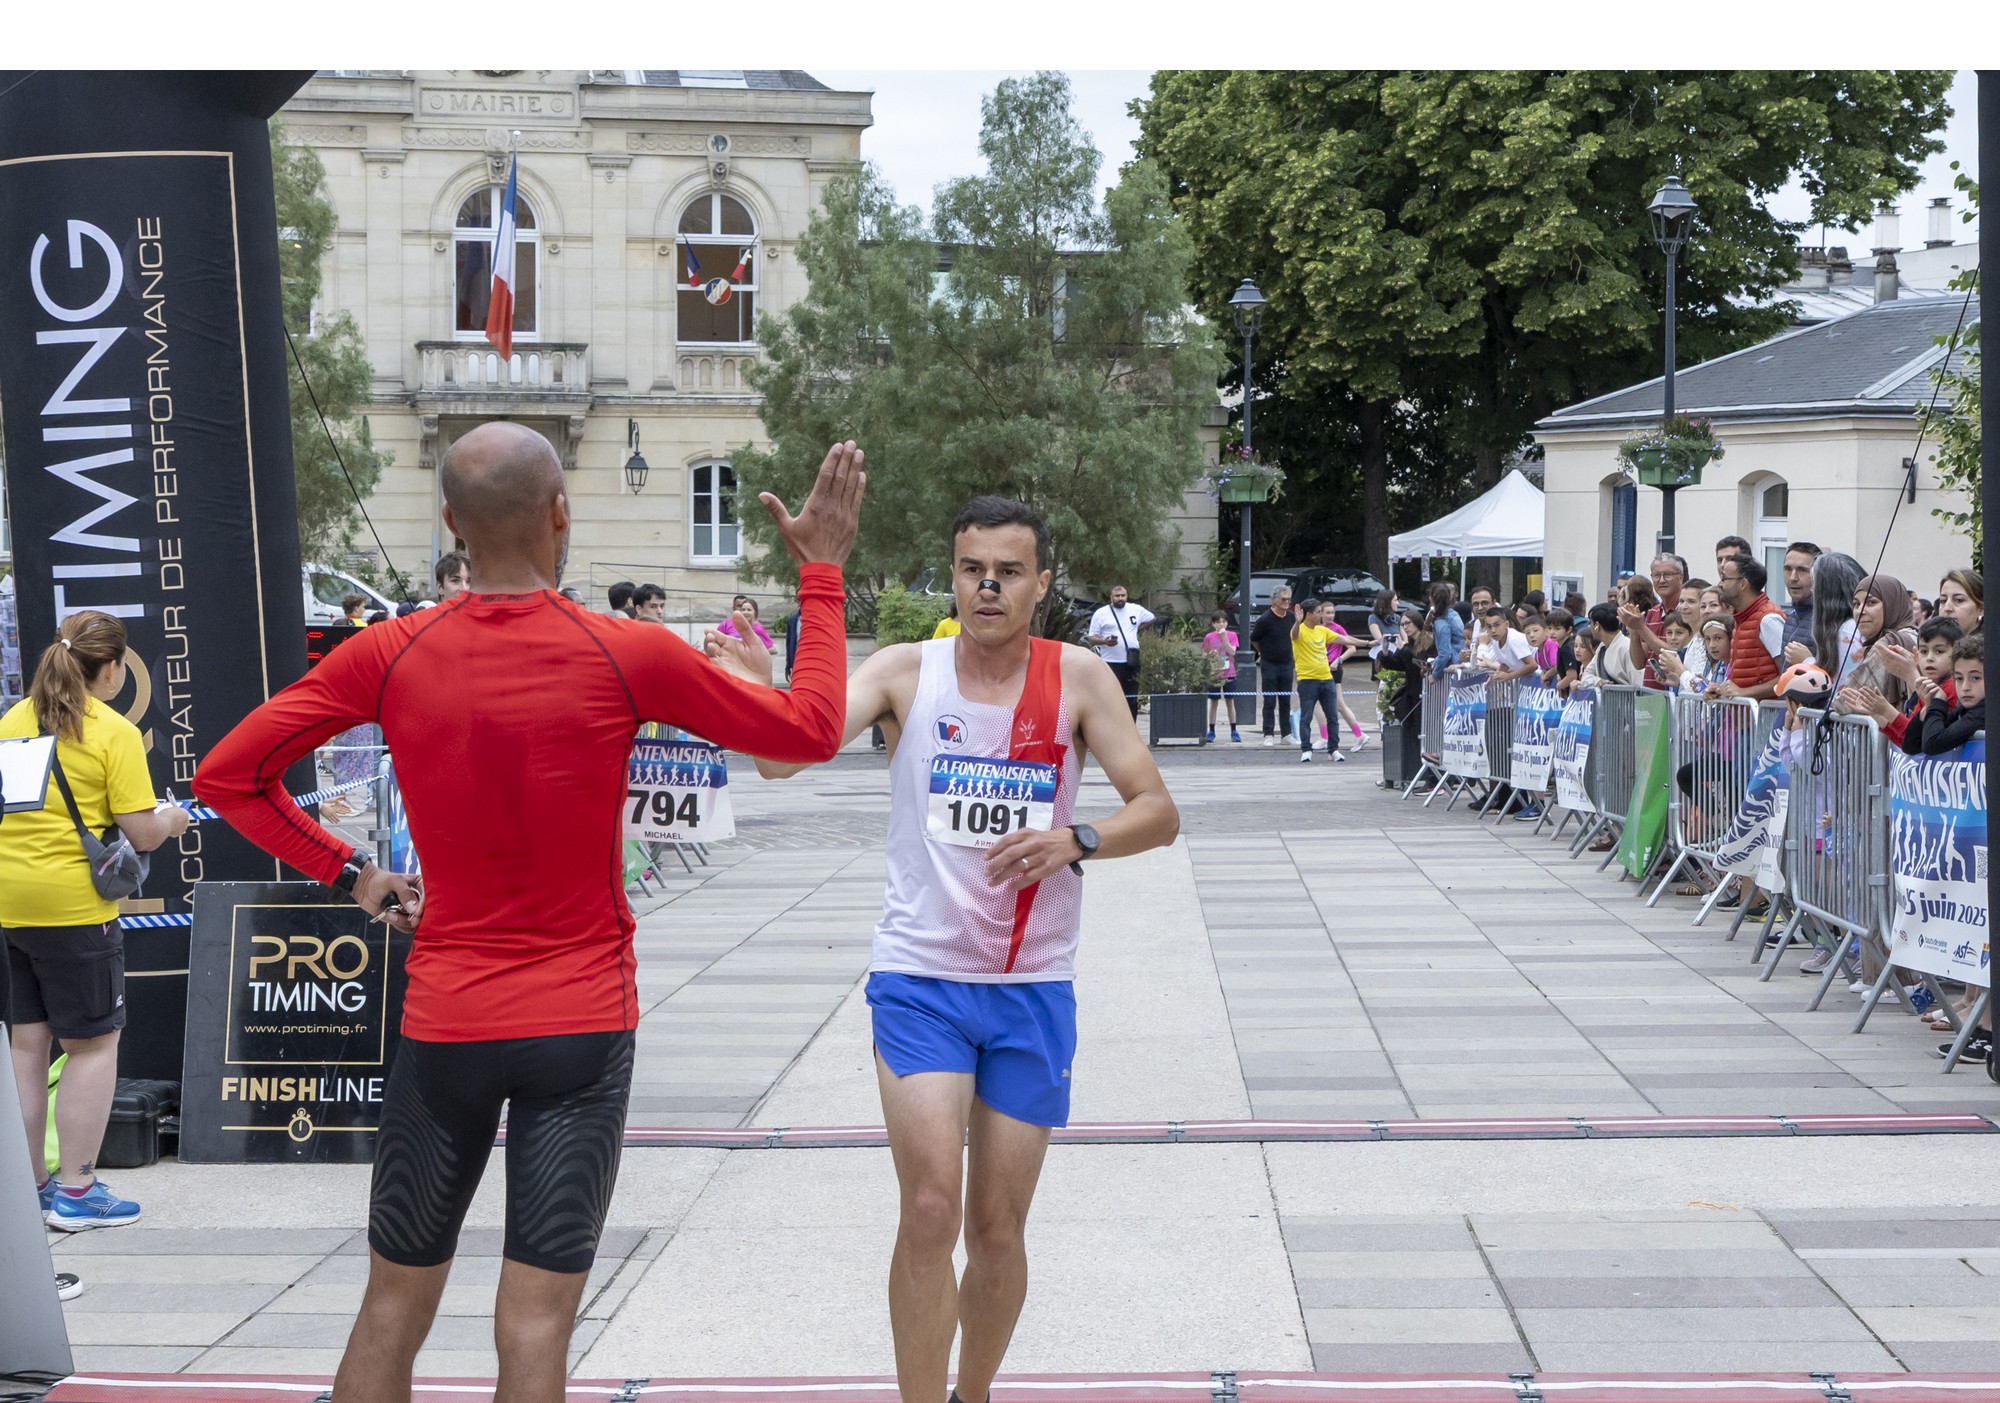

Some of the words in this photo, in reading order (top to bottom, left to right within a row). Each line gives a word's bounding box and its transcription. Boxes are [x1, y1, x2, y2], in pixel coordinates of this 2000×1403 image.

[450, 94, 543, 113] MAIRIE
[137, 217, 180, 524] PERFORMANCE
[30, 219, 146, 628] TIMING
[158, 536, 187, 590] DE
[1129, 616, 1137, 626] C
[932, 759, 948, 774] LA
[950, 760, 1054, 784] FONTENAISIENNE
[628, 790, 701, 828] 794
[948, 800, 1028, 836] 1091
[644, 831, 684, 840] MICHAEL
[974, 839, 995, 848] AHM
[1920, 892, 1957, 923] juin
[1957, 904, 1987, 927] 2025
[249, 935, 369, 980] PRO
[249, 981, 367, 1013] TIMING
[244, 1023, 368, 1035] www.protiming.fr
[221, 1077, 384, 1103] FINISHLINE
